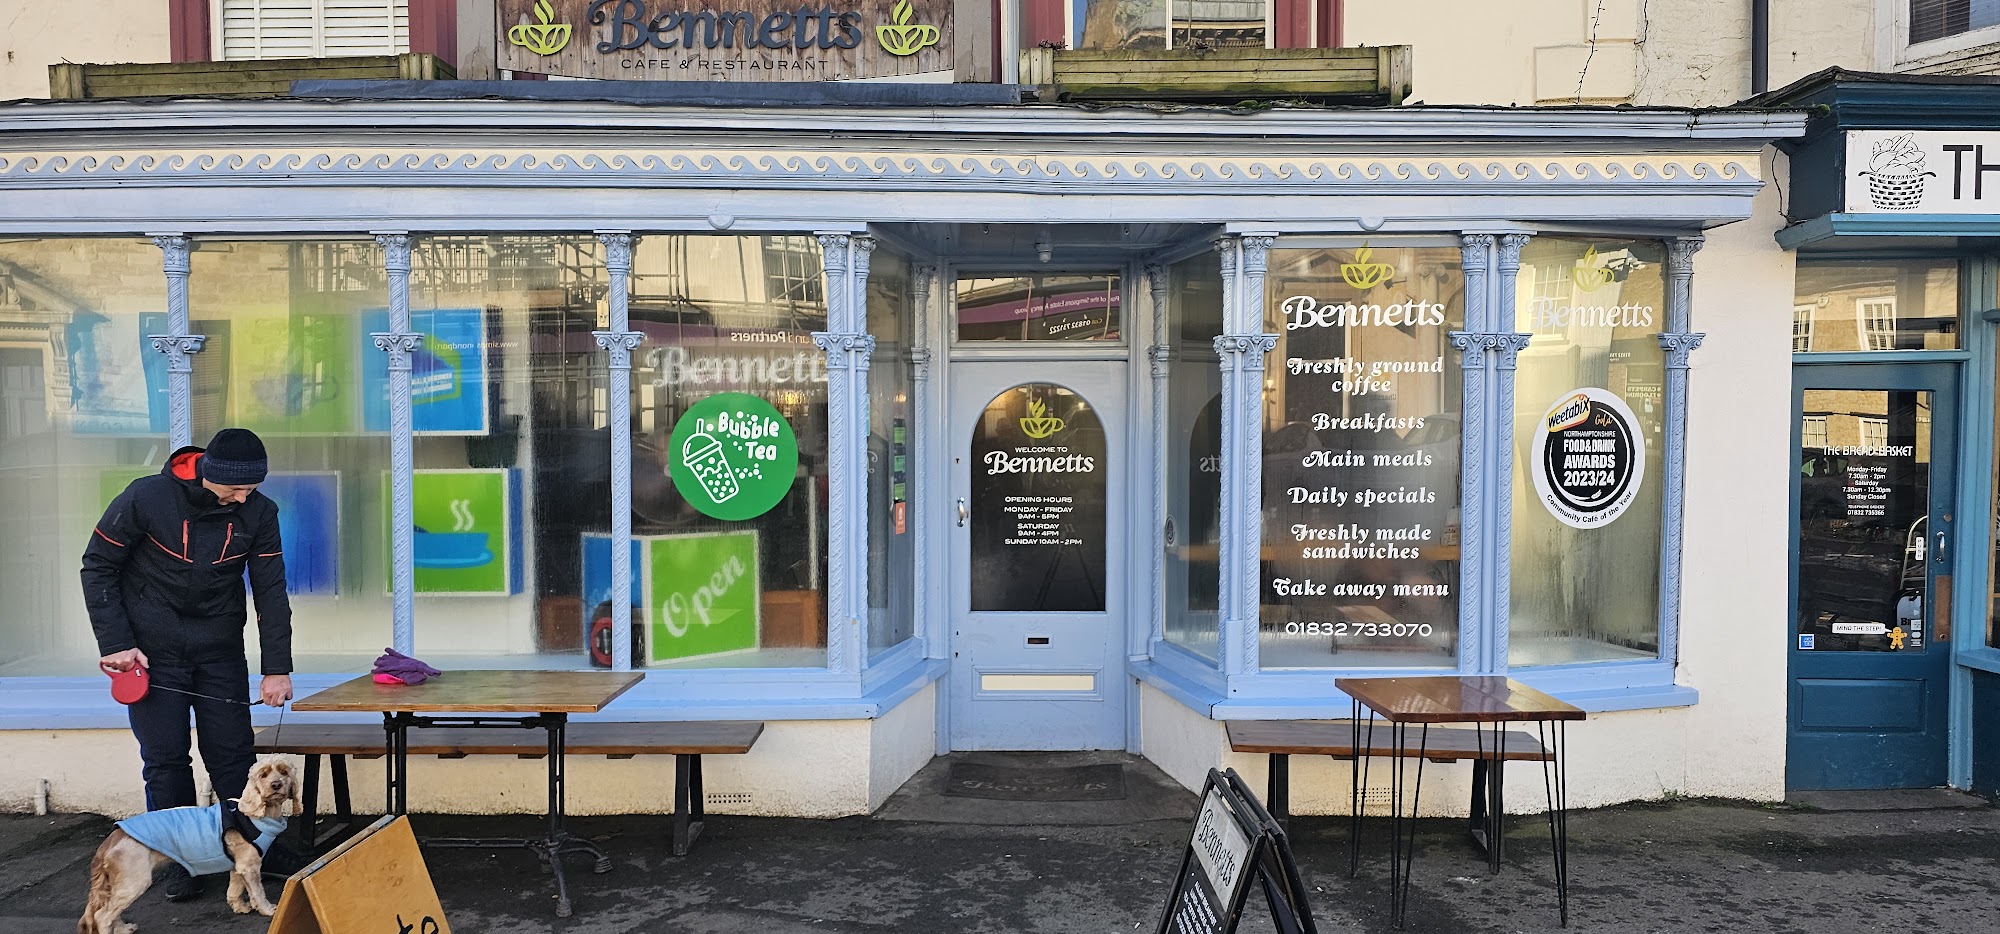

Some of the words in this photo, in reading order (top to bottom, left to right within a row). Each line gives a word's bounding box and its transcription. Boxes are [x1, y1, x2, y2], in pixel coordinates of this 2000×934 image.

[587, 0, 862, 54] Bennetts
[621, 59, 672, 70] CAFE
[678, 59, 690, 70] &
[699, 59, 829, 71] RESTAURANT
[1281, 295, 1445, 331] Bennetts
[1525, 296, 1653, 329] Bennetts
[645, 346, 828, 388] Bennett
[1286, 357, 1365, 377] Freshly
[1370, 357, 1444, 377] ground
[1331, 376, 1392, 396] coffee
[1311, 412, 1425, 433] Breakfasts
[1548, 397, 1591, 429] Weetabix
[1594, 413, 1614, 427] Gold
[718, 411, 780, 440] Bubble
[1563, 430, 1616, 438] NORTHAMPTONSHIRE
[745, 441, 777, 461] Tea
[1302, 449, 1365, 468] Main
[1373, 450, 1432, 467] meals
[1563, 454, 1616, 469] AWARDS
[1823, 446, 1840, 456] THE
[1842, 446, 1875, 456] BREAD
[1878, 446, 1914, 457] BASKET
[983, 450, 1095, 476] Bennetts
[1563, 470, 1615, 487] 2023/24
[1286, 486, 1349, 507] Daily
[1354, 486, 1436, 508] specials
[1546, 494, 1581, 523] Community
[1600, 512, 1607, 520] of
[1608, 506, 1620, 517] the
[1619, 490, 1633, 506] Year
[1290, 523, 1370, 544] Freshly
[1376, 523, 1432, 541] made
[1302, 542, 1420, 560] sandwiches
[662, 555, 745, 638] Open
[1272, 577, 1327, 597] Take
[1333, 583, 1387, 600] away
[1393, 583, 1450, 597] menu
[1285, 621, 1348, 637] 01832
[1352, 622, 1433, 637] 733070
[1198, 808, 1236, 887] Bennetts
